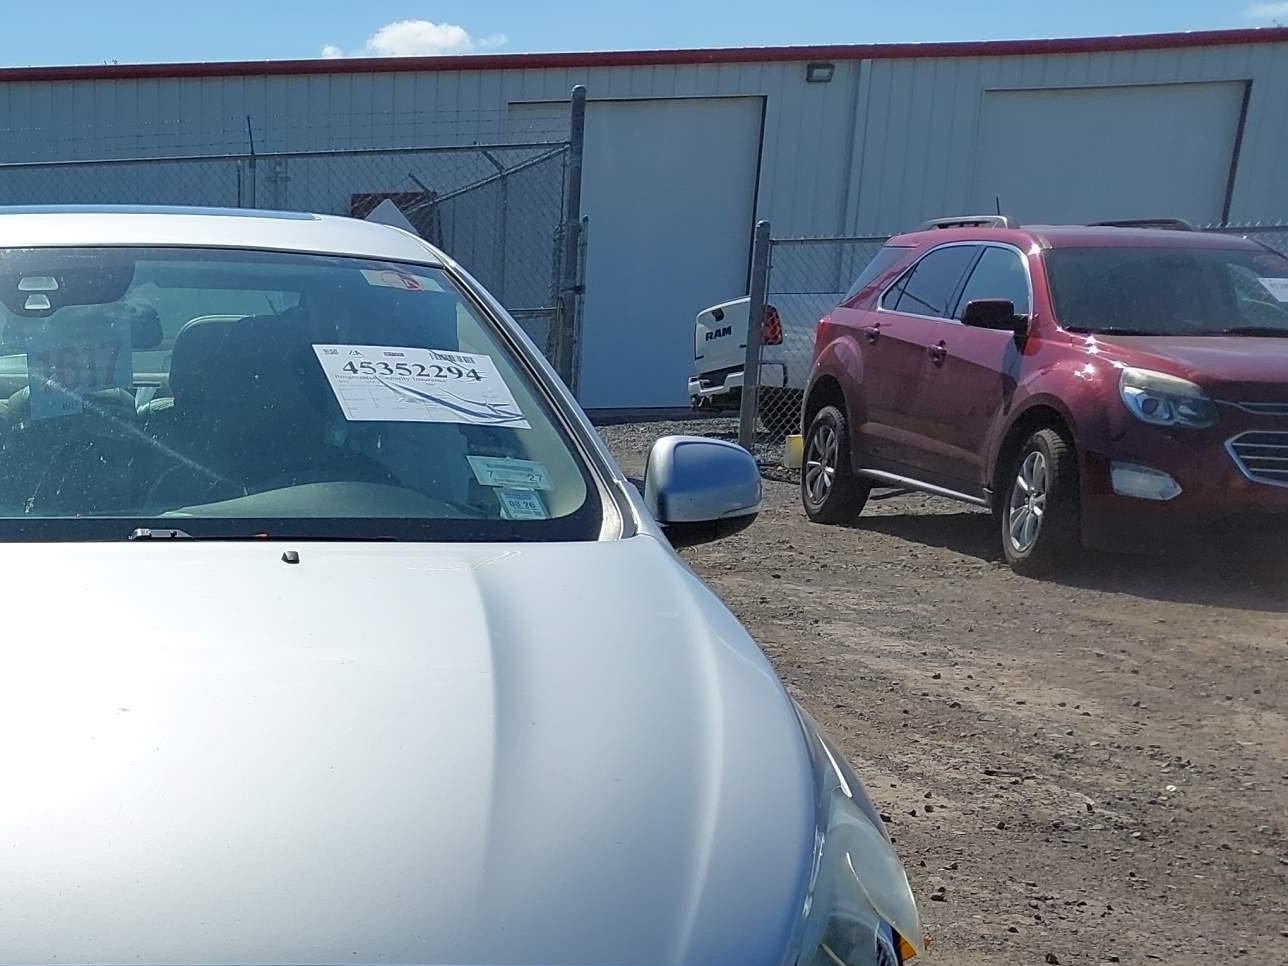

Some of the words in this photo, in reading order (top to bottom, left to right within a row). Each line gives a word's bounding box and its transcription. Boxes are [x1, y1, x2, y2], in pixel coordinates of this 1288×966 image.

[705, 326, 732, 341] RAM
[342, 360, 482, 382] 45352294
[527, 473, 544, 481] 27
